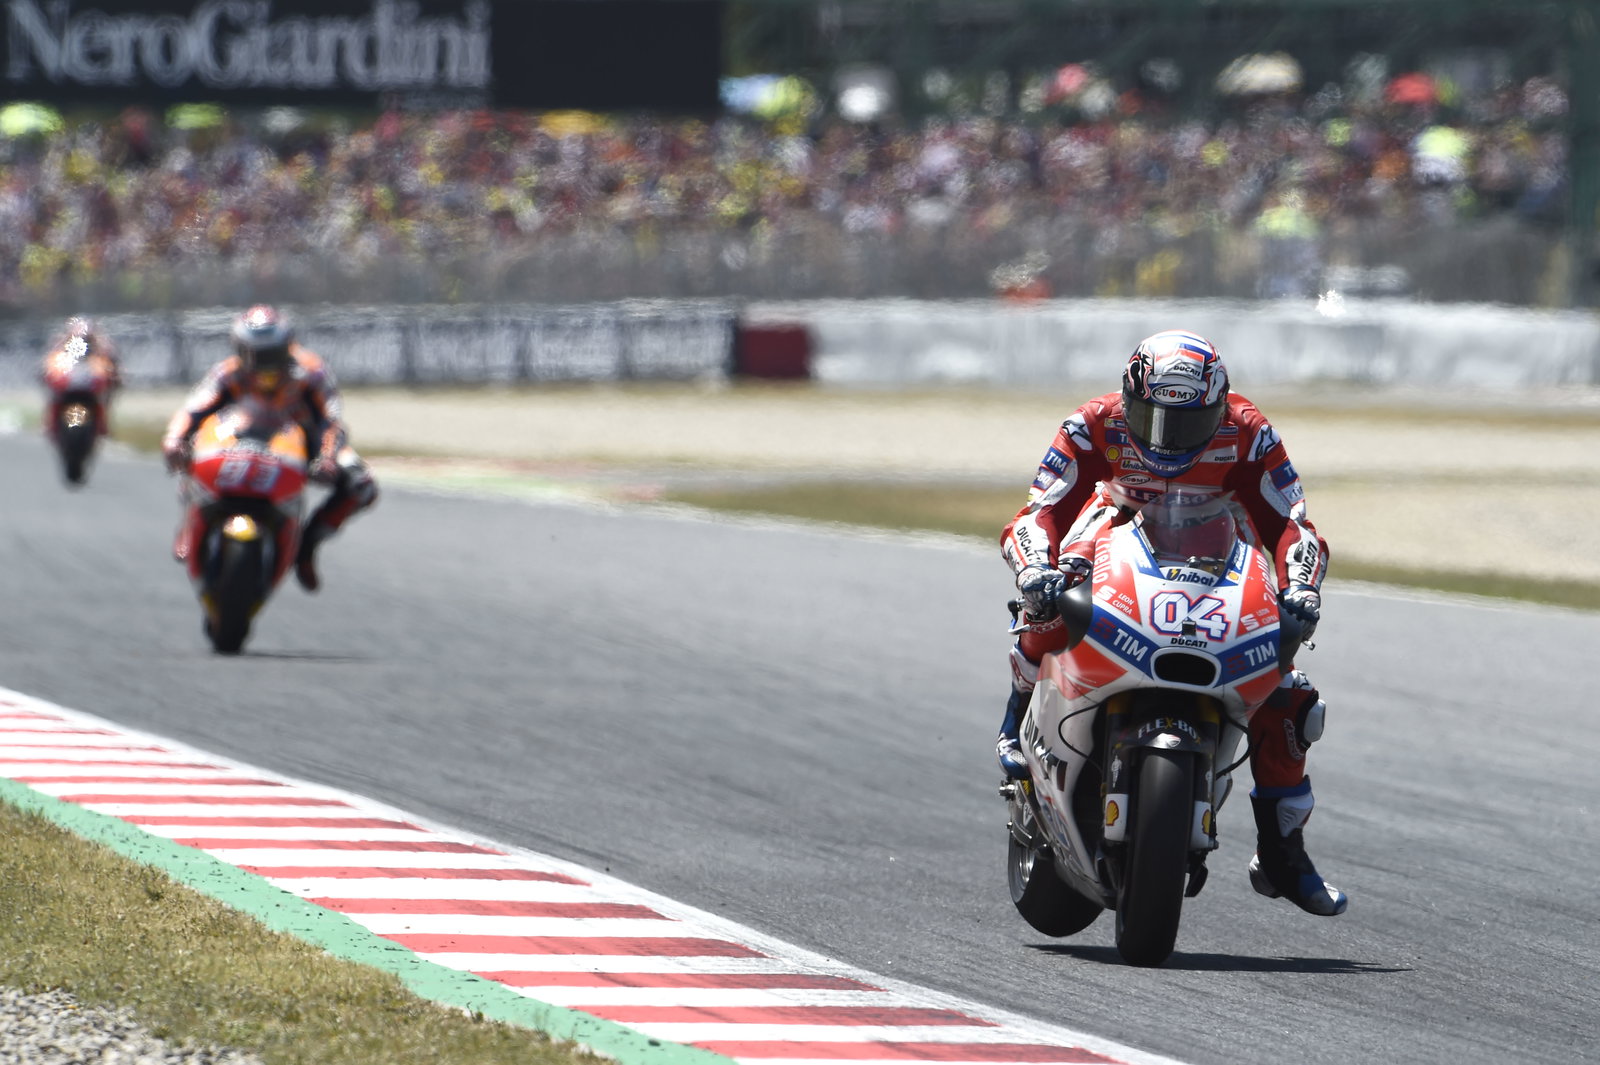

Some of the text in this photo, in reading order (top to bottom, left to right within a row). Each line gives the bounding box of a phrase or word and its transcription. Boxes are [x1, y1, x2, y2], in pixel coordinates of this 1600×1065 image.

[5, 0, 491, 88] NeroGiardini
[1173, 364, 1201, 377] DUCATI
[1156, 388, 1195, 400] SUOMY
[1046, 451, 1067, 472] TIM
[1298, 541, 1318, 582] DUCATI
[1166, 569, 1214, 587] Unibat
[1112, 600, 1133, 615] CUPRA
[1118, 593, 1135, 605] LEON
[1148, 590, 1231, 643] 04
[1112, 628, 1149, 662] TIM
[1170, 637, 1208, 648] DUCATI
[1244, 641, 1277, 666] TIM
